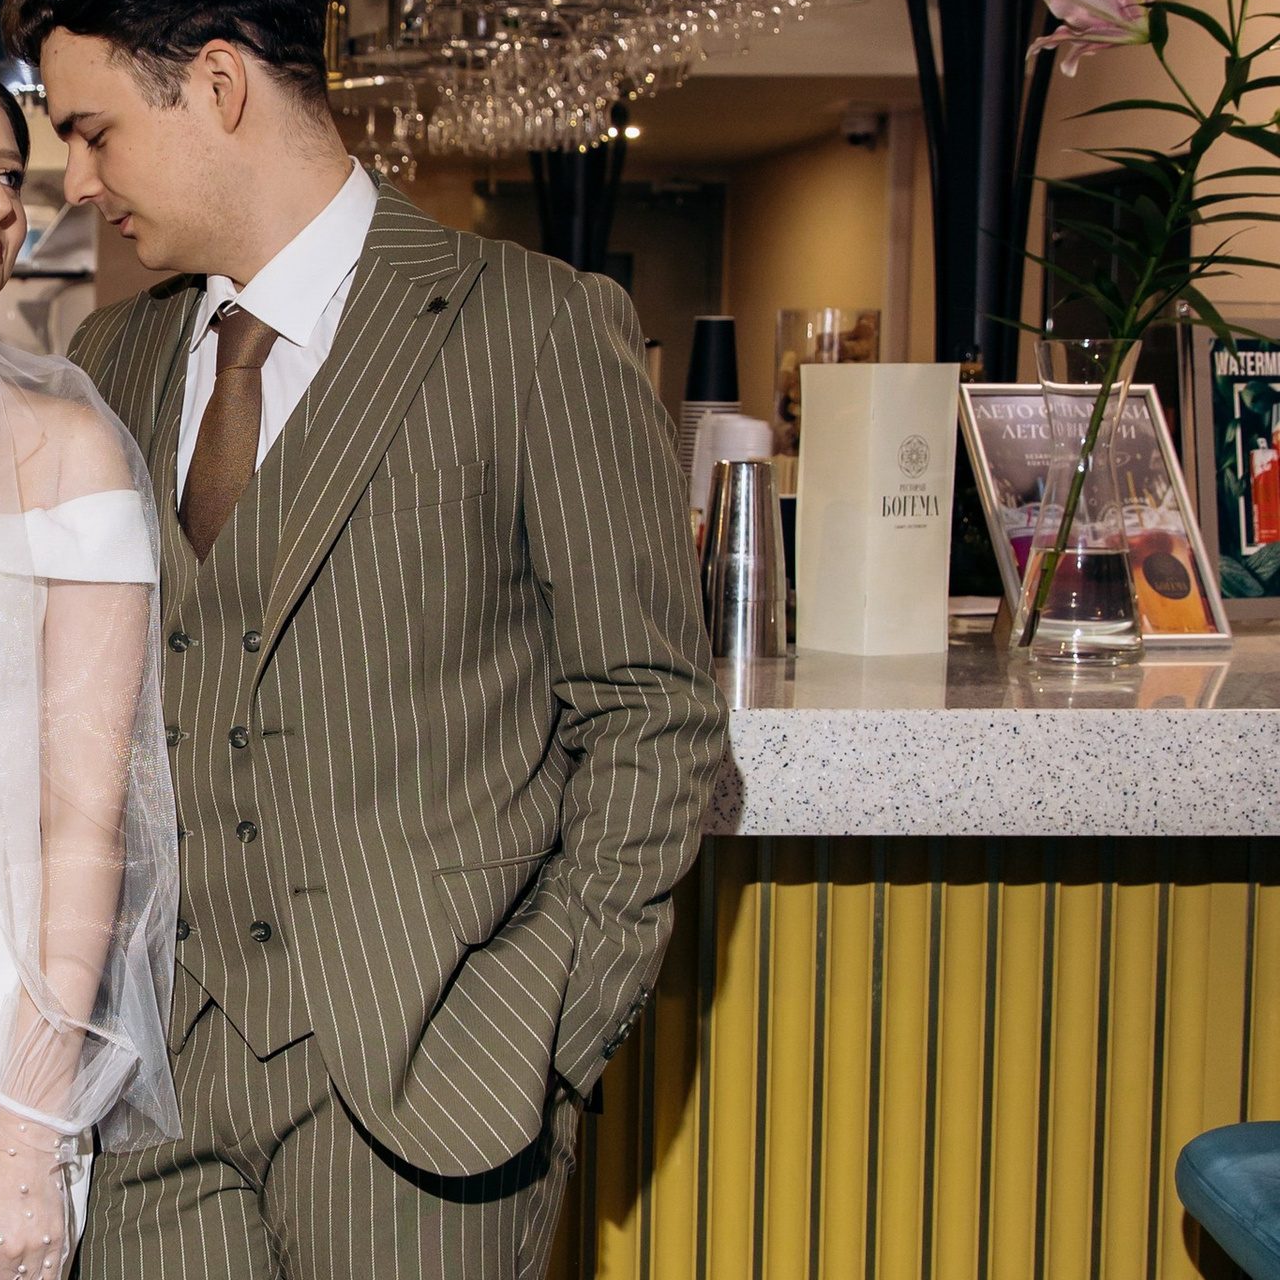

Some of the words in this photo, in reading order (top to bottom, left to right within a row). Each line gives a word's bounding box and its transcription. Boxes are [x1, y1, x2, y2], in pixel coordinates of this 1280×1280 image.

[1214, 351, 1280, 376] WATERM
[976, 403, 1033, 419] ЛЕТО
[882, 495, 939, 517] БОГЕМА
